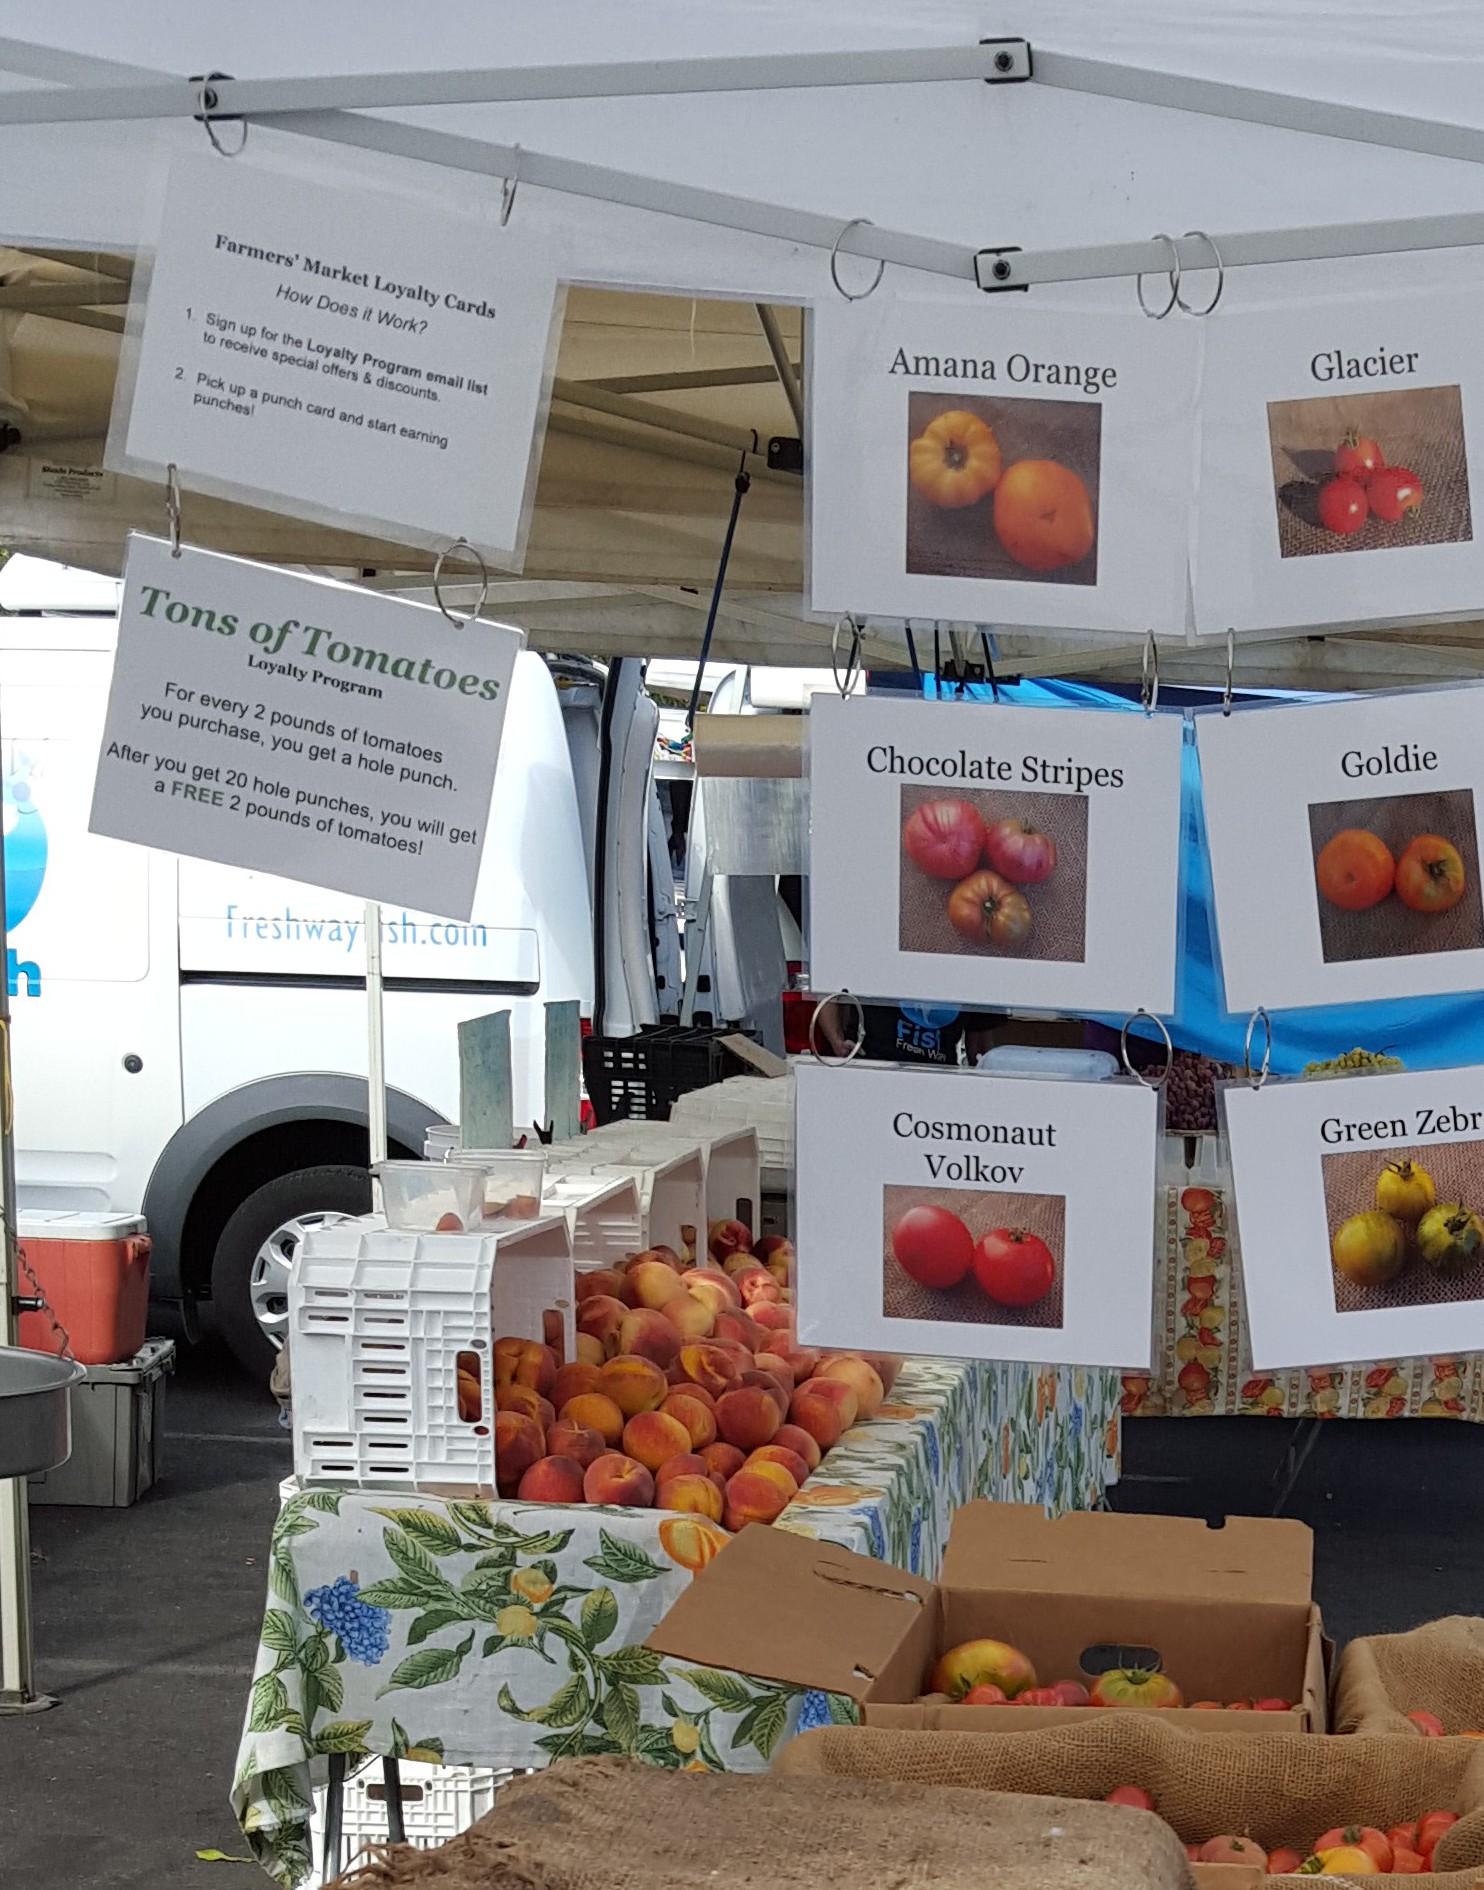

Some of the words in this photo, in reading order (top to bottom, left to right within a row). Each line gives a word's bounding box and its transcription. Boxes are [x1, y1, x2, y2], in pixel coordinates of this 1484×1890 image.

[215, 234, 299, 267] Farmers’
[303, 257, 368, 287] Market
[374, 275, 440, 308] Loyalty
[444, 294, 496, 318] Cards
[276, 284, 314, 306] How
[316, 295, 359, 318] Does
[362, 308, 373, 322] it
[378, 309, 428, 334] Work?
[203, 331, 216, 344] to
[220, 338, 268, 358] receive
[272, 351, 319, 371] special
[322, 362, 358, 382] offers
[363, 372, 372, 384] &
[376, 376, 440, 402] discounts.
[206, 312, 236, 332] Sign
[240, 324, 257, 338] up
[261, 326, 279, 342] for
[282, 333, 303, 348] the
[307, 338, 358, 365] Loyalty
[362, 352, 422, 379] Program
[426, 372, 464, 389] email
[467, 379, 488, 396] list
[888, 347, 996, 380] Amana
[1007, 354, 1117, 394] Orange
[1311, 346, 1419, 382] Glacier
[193, 393, 255, 416] punches!
[197, 372, 225, 392] Pick
[229, 383, 246, 398] up
[250, 389, 258, 399] a
[262, 392, 302, 410] punch
[306, 403, 336, 419] card
[339, 412, 364, 426] and
[367, 418, 396, 434] start
[400, 427, 448, 450] earning
[140, 586, 239, 636] Tons
[249, 620, 300, 654] of
[302, 625, 500, 700] Tomatoes
[248, 654, 308, 682] Loyalty
[312, 670, 382, 699] Program
[165, 682, 196, 702] For
[200, 694, 249, 719] every
[254, 704, 266, 720] 2
[270, 711, 335, 737] pounds
[341, 727, 358, 742] of
[363, 730, 442, 764] tomatoes
[140, 704, 173, 722] you
[178, 713, 264, 747] purchase,
[271, 735, 304, 753] you
[308, 745, 336, 762] get
[341, 753, 352, 766] a
[358, 753, 394, 776] hole
[399, 767, 457, 792] punch.
[867, 745, 1012, 781] Chocolate
[1022, 756, 1124, 793] Stripes
[1341, 744, 1438, 778] Goldie
[106, 741, 150, 765] After
[154, 756, 186, 774] you
[192, 765, 220, 782] get
[225, 769, 248, 788] 20
[253, 776, 290, 799] hole
[295, 790, 373, 822] punches,
[380, 810, 412, 828] you
[418, 819, 444, 836] will
[449, 828, 476, 844] get
[154, 780, 165, 794] a
[171, 781, 225, 807] FREE
[229, 795, 241, 811] 2
[245, 802, 310, 828] pounds
[316, 818, 335, 833] of
[338, 821, 423, 855] tomatoes!
[897, 1019, 940, 1051] Fis
[893, 1112, 1056, 1147] Cosmonaut
[1320, 1118, 1408, 1144] Green
[924, 1154, 1024, 1184] Volkov
